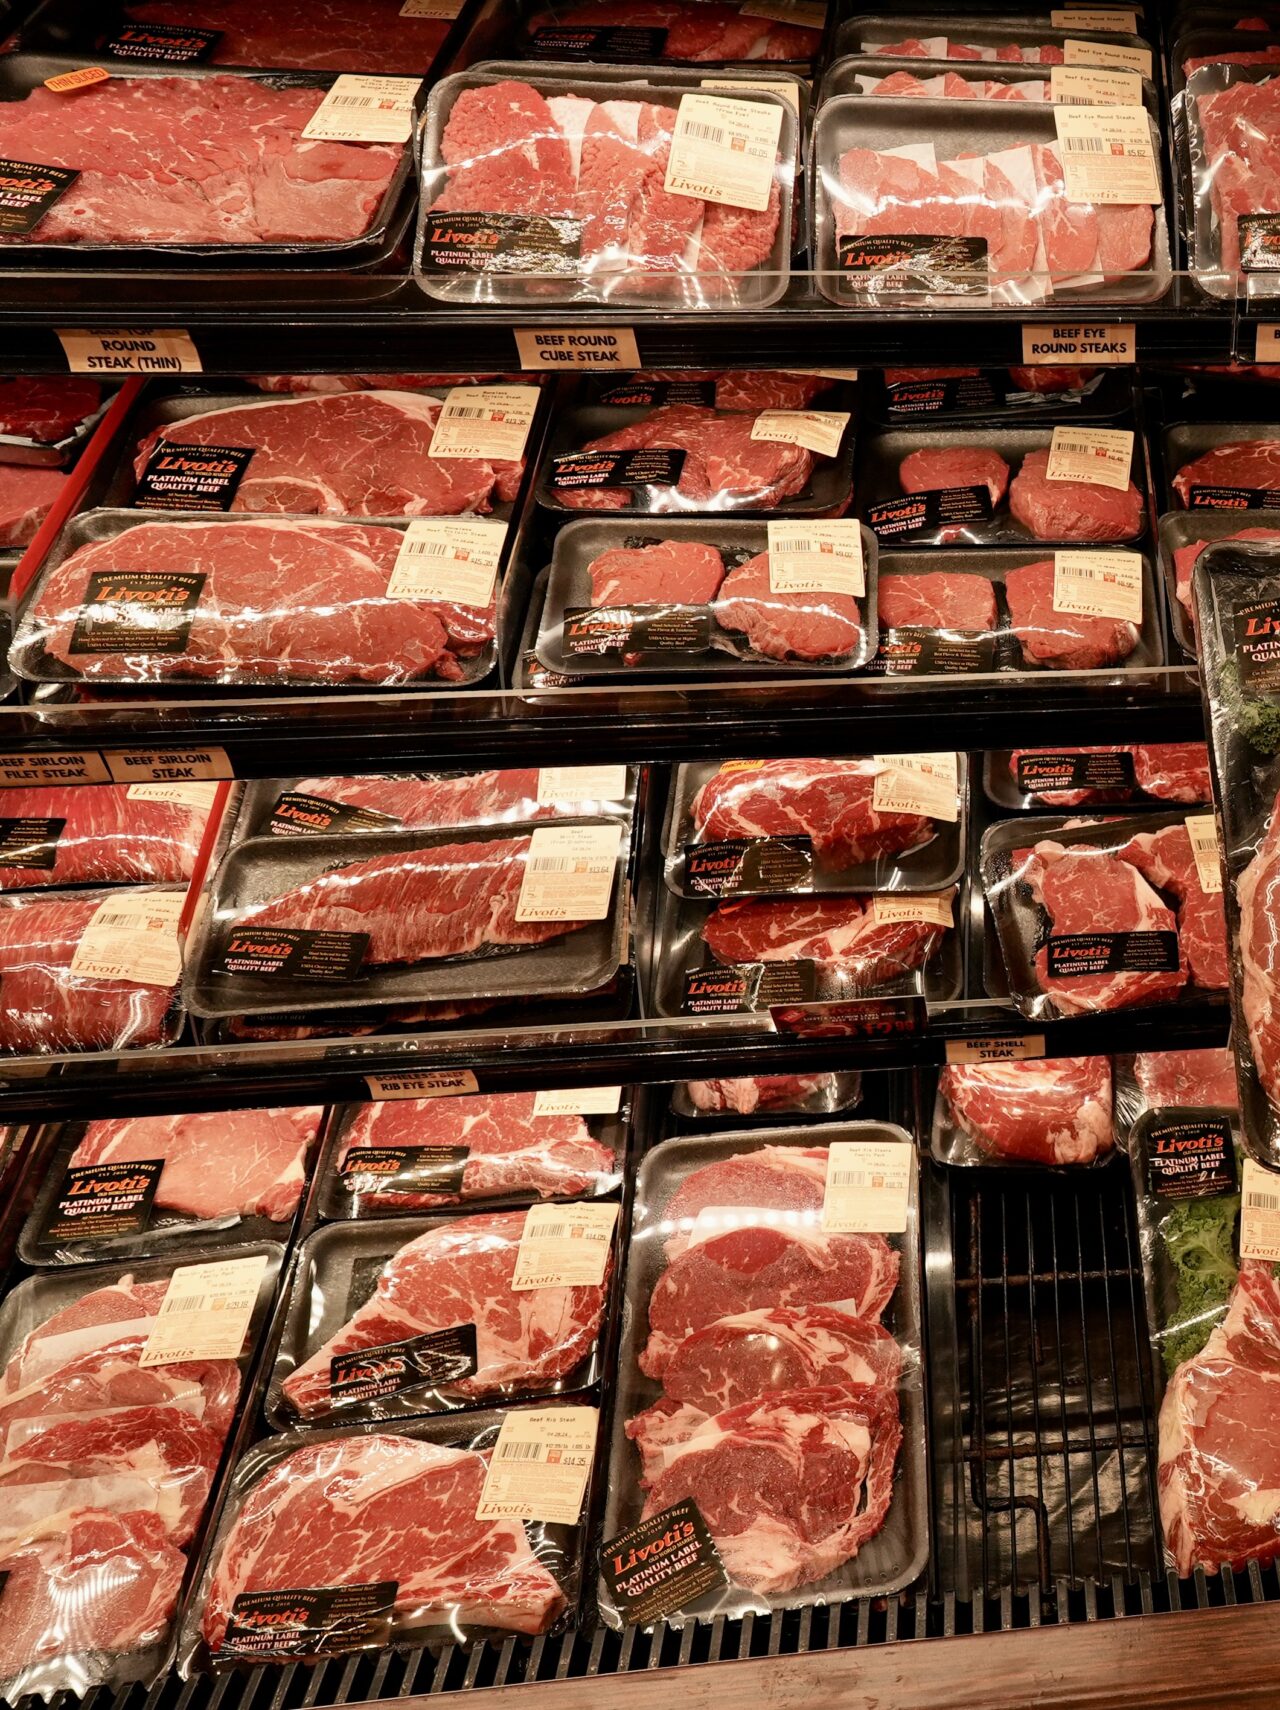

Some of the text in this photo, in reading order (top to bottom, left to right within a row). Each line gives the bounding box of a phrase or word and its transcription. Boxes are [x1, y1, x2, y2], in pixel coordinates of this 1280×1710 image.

[119, 31, 207, 49] Livoti's
[49, 68, 105, 91] THIN SLICED
[669, 177, 723, 198] Livoti's
[431, 229, 499, 245] Livoti's
[535, 335, 617, 346] BEEF ROUND
[1052, 328, 1106, 339] BEEF EYE
[101, 340, 157, 353] ROUND
[1031, 342, 1127, 354] ROUND STEAKS
[539, 350, 620, 361] CUBE STEAK
[87, 356, 182, 371] STEAK (THIN)
[156, 455, 238, 474] Livoti's
[557, 460, 614, 472] Livoti's
[147, 474, 229, 485] PLATINUM LABEL
[151, 482, 221, 493] QUALITY BEEF
[1195, 496, 1249, 509] Livoti's
[871, 504, 926, 523] Livoti's
[94, 586, 190, 603] Livoti's
[28, 755, 86, 767] SIRLOIN
[123, 753, 211, 766] BEEF SIRLOIN
[5, 768, 88, 779] FILET STEAK
[152, 767, 195, 779] STEAK
[1023, 764, 1074, 776] Livoti's
[275, 804, 330, 826] Livoti's
[690, 857, 743, 873] Livoti's
[227, 941, 292, 955] Livoti's
[1053, 946, 1111, 959] Livoti's
[994, 1040, 1026, 1048] SHELL
[979, 1049, 1014, 1057] STEAK
[380, 1078, 465, 1091] RIB EYE STEAK
[1157, 1133, 1224, 1154] Livoti's
[346, 1159, 401, 1173] Livoti's
[1153, 1152, 1227, 1167] PLATINUM LABEL
[1161, 1160, 1221, 1175] QUALITY BEEF
[69, 1176, 151, 1196] Livoti's
[59, 1194, 144, 1209] PLATINUM LABEL
[63, 1202, 136, 1216] QUALITY BEEF
[516, 1274, 561, 1286] Livoti's
[143, 1347, 196, 1362] Livoti's
[563, 1456, 586, 1466] $14.35
[481, 1502, 533, 1517] Livoti's
[613, 1521, 695, 1575] Livoti's
[648, 1534, 697, 1563] OLD WORLD MARKET
[615, 1540, 702, 1593] PLATINUM LABEL
[627, 1552, 699, 1596] QUALITY BEEF
[236, 1607, 309, 1628] Livoti's
[231, 1632, 300, 1645] PLATINUM LABEL
